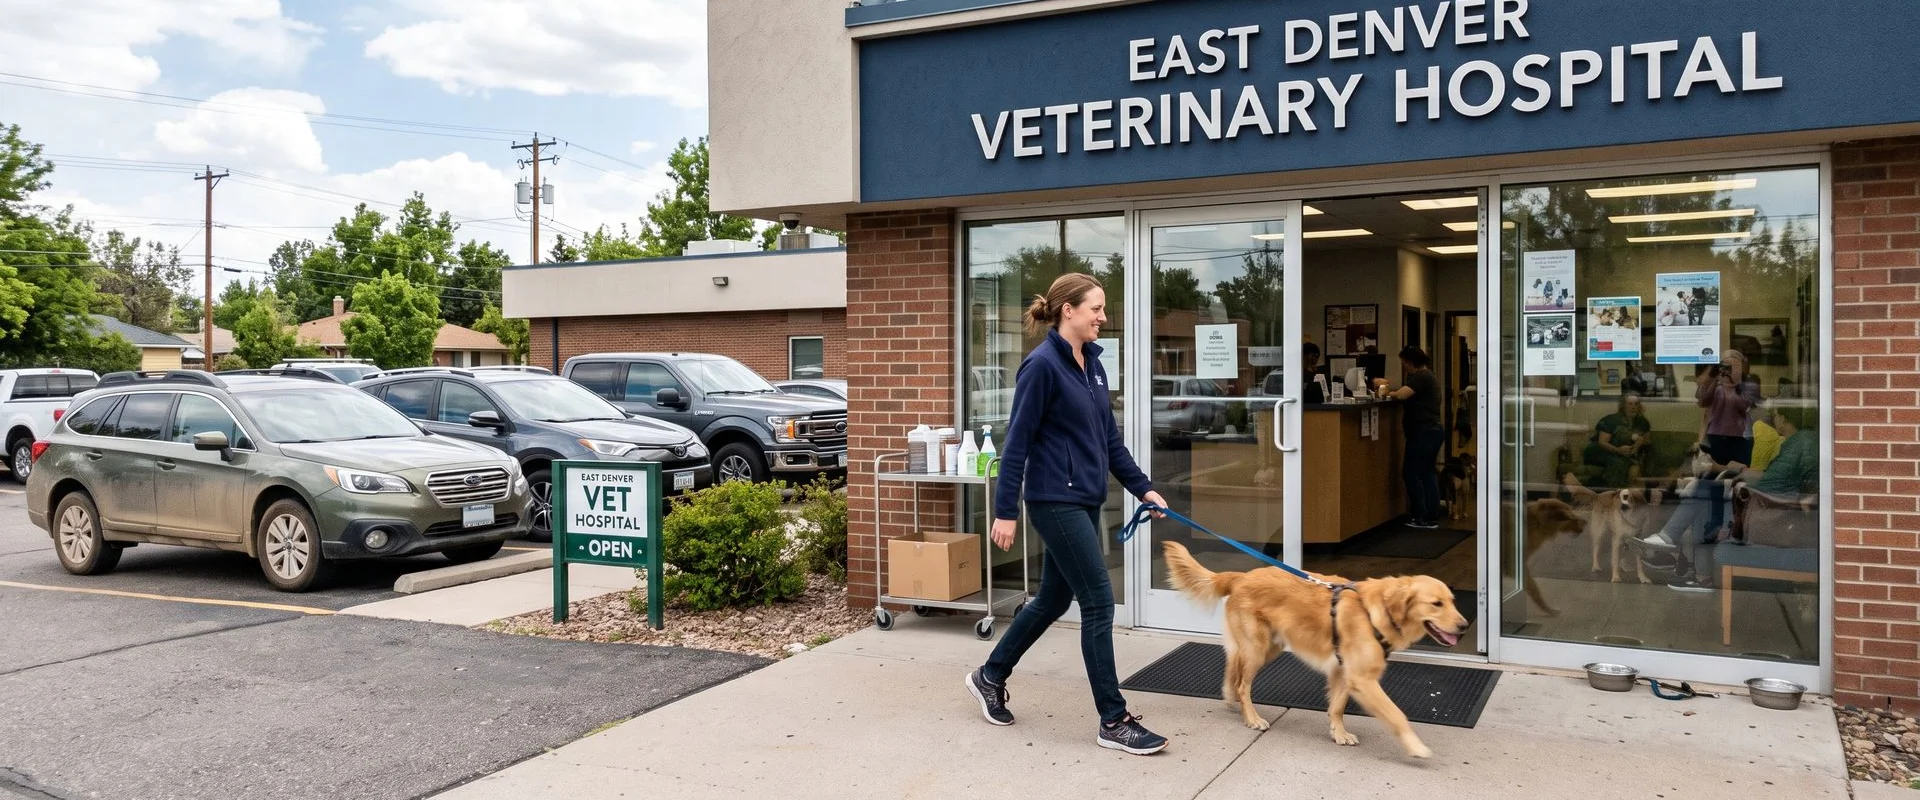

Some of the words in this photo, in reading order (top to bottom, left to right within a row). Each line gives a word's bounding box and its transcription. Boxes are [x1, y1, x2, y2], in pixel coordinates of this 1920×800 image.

[1129, 25, 1260, 82] EAST
[1285, 0, 1530, 64] DENVER
[971, 73, 1364, 160] VETERINARY
[1395, 31, 1783, 123] HOSPITAL
[581, 473, 600, 482] EAST
[601, 474, 634, 483] DENVER
[583, 485, 632, 512] VET
[575, 513, 641, 530] HOSPITAL
[588, 539, 633, 559] OPEN
